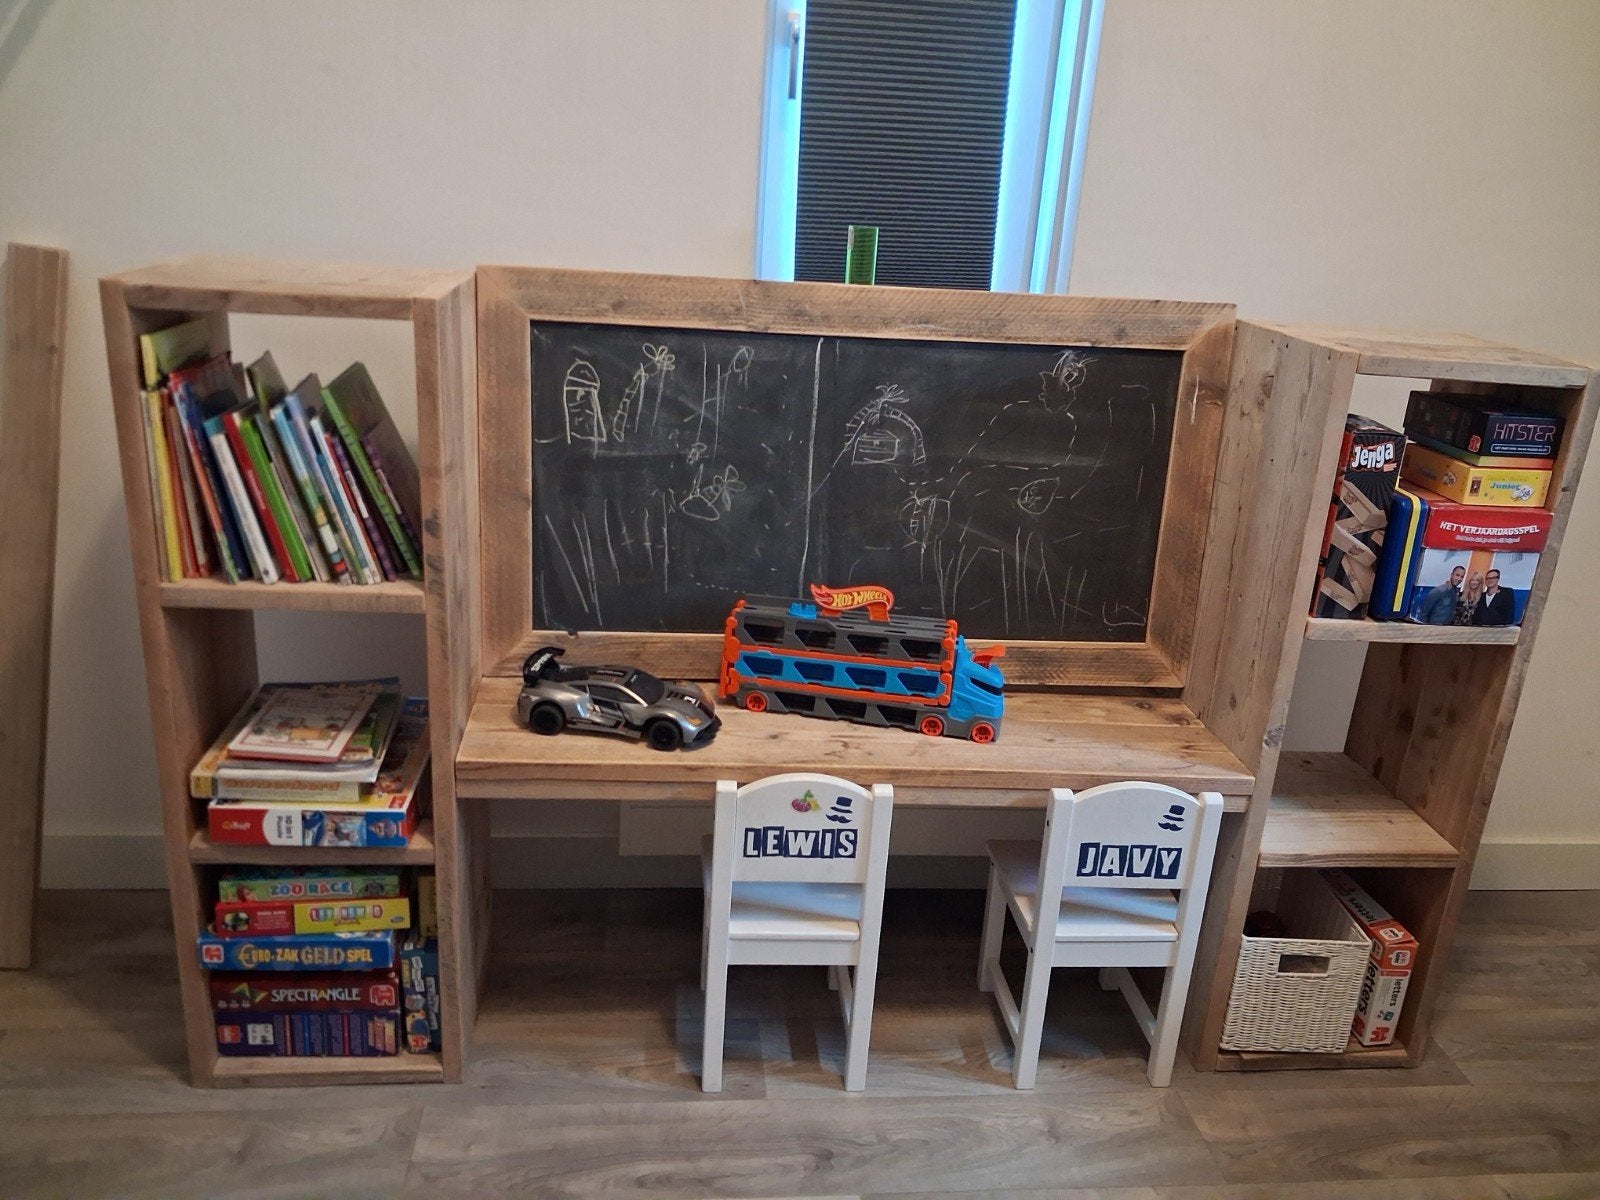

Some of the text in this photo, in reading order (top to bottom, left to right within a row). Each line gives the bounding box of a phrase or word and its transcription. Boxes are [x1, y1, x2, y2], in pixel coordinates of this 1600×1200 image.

[1494, 423, 1556, 442] HITSTER
[1351, 443, 1394, 468] Jenga
[1490, 481, 1522, 491] Junior
[1440, 521, 1540, 536] HET VERJAARDAGSSPEL
[830, 590, 888, 607] HOT WHEELS
[744, 829, 857, 859] LEWIS
[1078, 843, 1182, 879] JAVY
[308, 880, 353, 896] RACE
[301, 946, 346, 967] GELD
[347, 949, 372, 963] SPEL
[271, 988, 361, 1002] SPECTRANGLE
[1358, 961, 1378, 1016] letters
[1390, 978, 1404, 1007] letters
